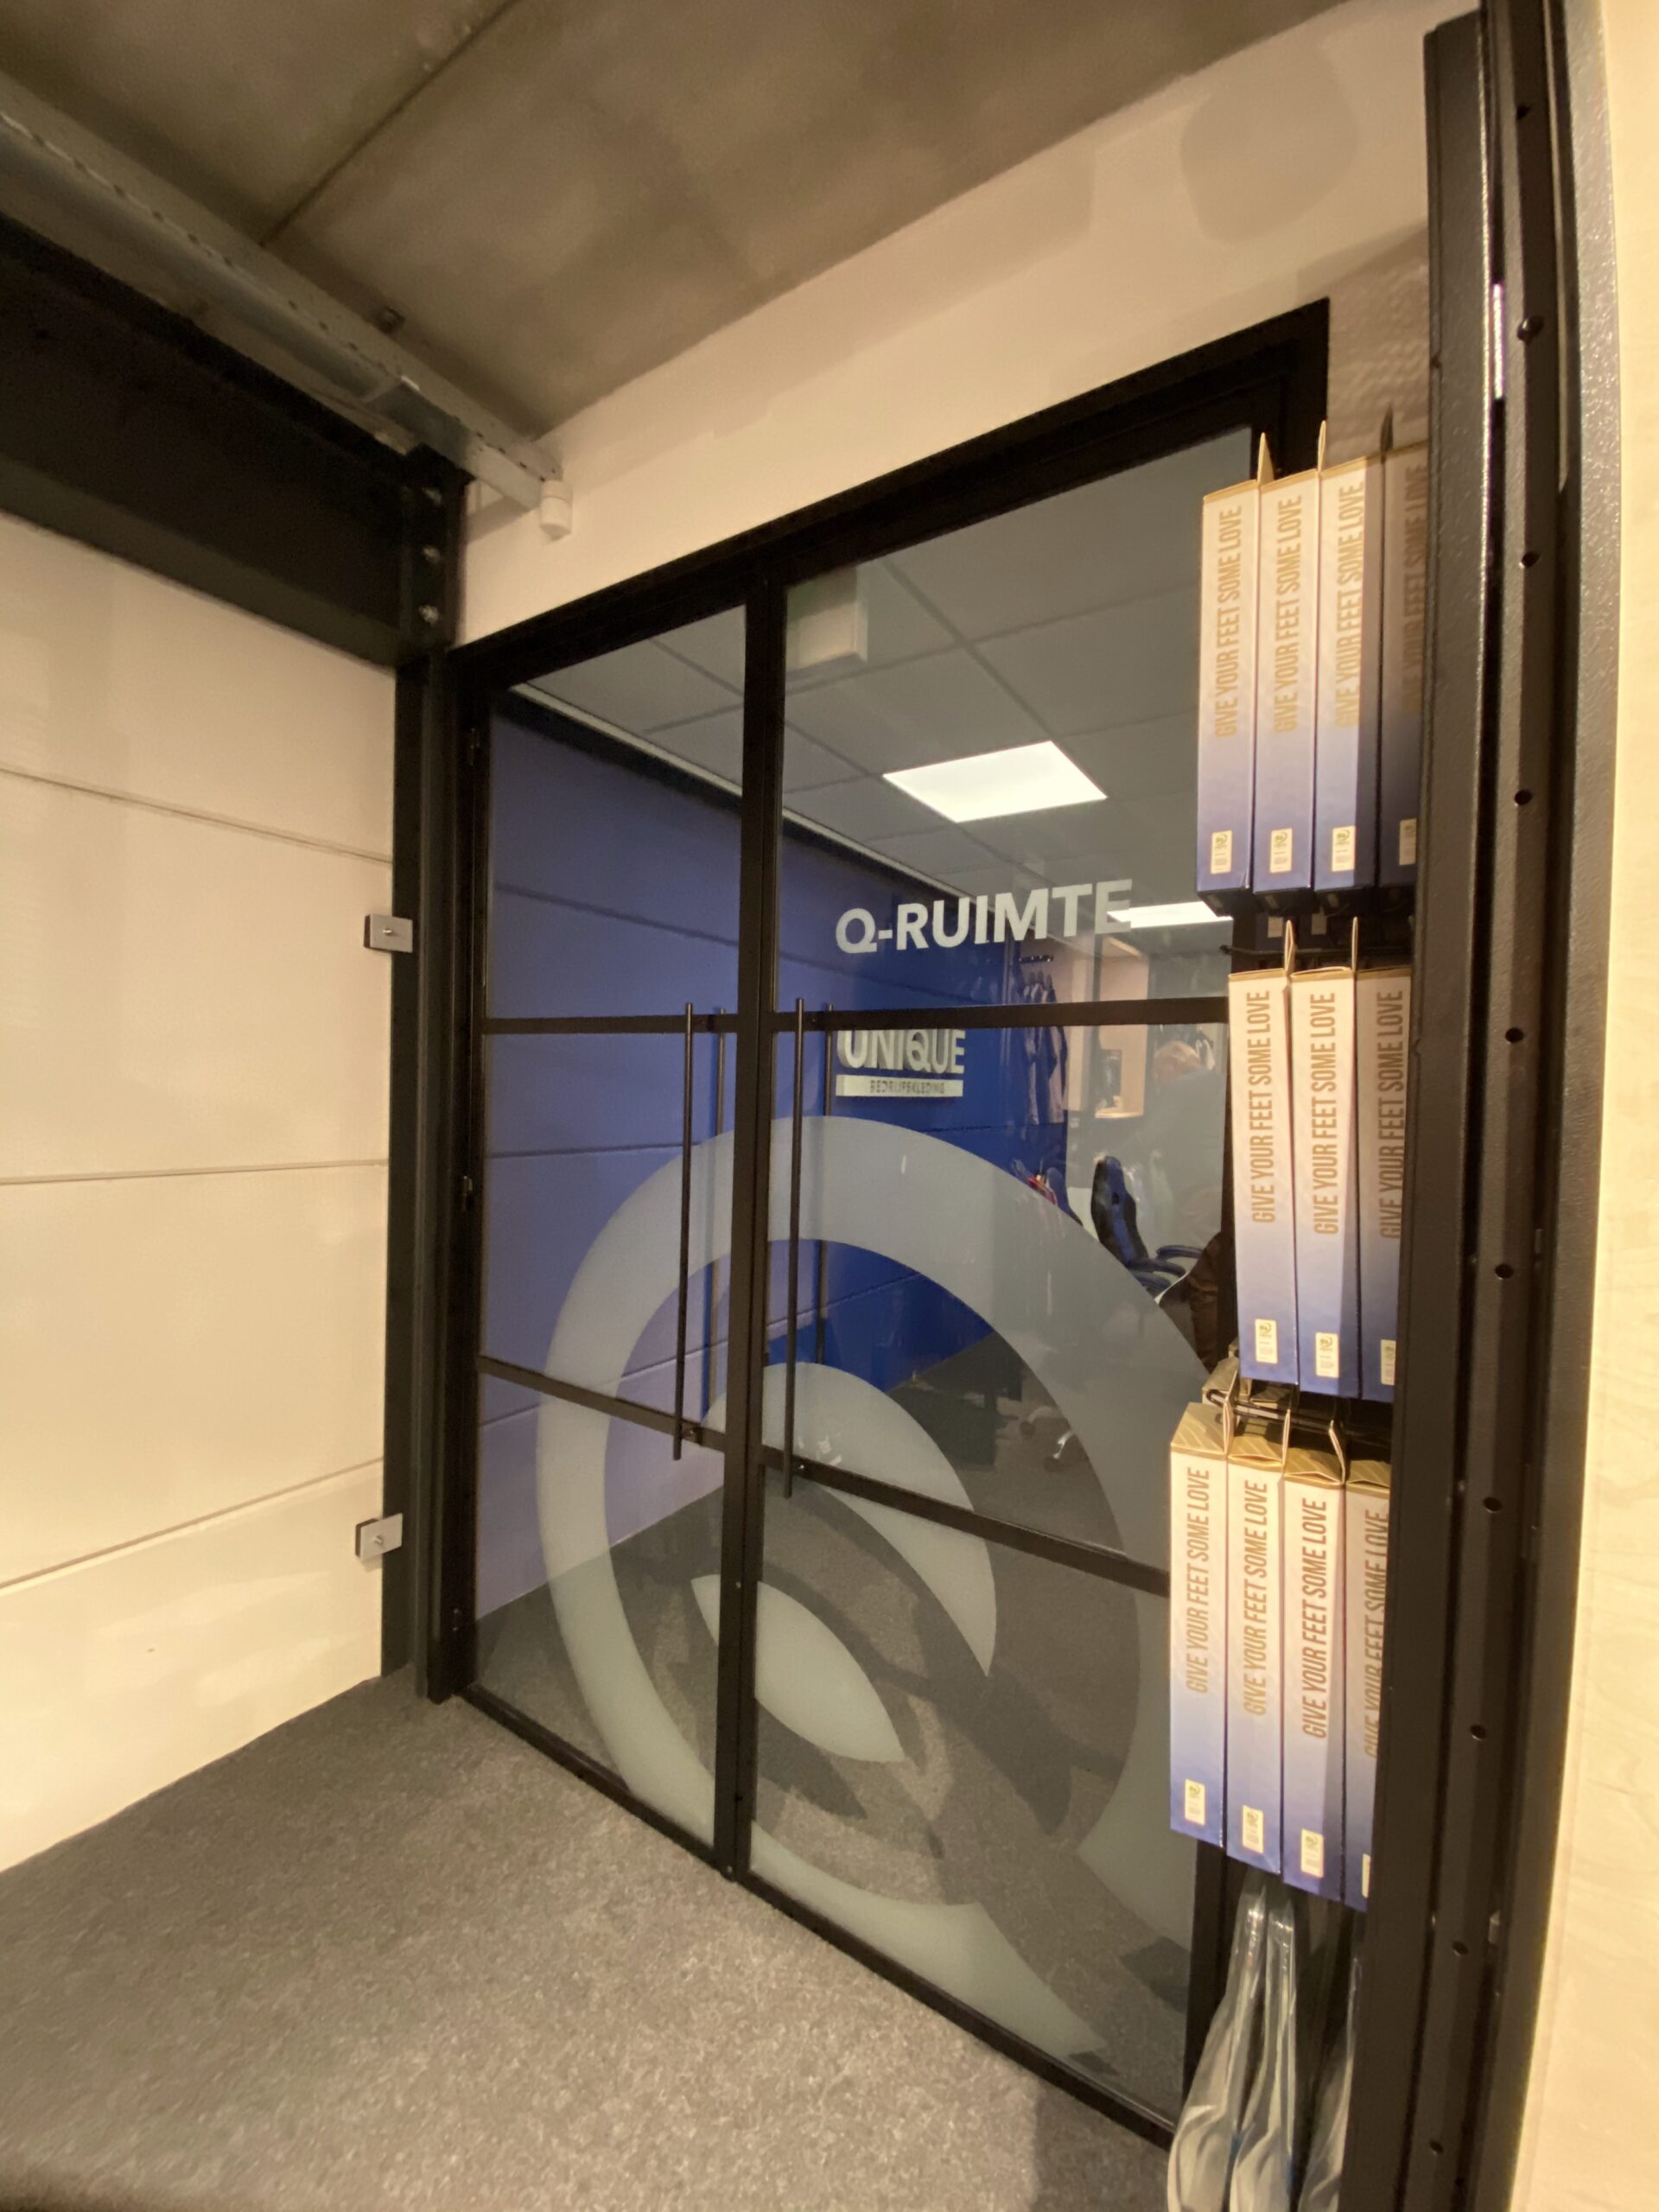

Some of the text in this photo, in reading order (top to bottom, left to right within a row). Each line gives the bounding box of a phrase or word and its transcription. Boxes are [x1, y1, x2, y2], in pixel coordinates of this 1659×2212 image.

[1215, 505, 1242, 738] GIVE YOUR FEET SOME LOVE
[1274, 495, 1301, 733] GIVE YOUR FEET SOME LOVE
[1336, 481, 1363, 727] GIVE YOUR FEET SOME LOVE
[836, 879, 1132, 954] Q-RUIMTE
[836, 1028, 966, 1074] UNIQUE
[1246, 989, 1276, 1224] GIVE YOUR FEET SOME LOVE
[1310, 992, 1339, 1236] GIVE YOUR FEET SOME LOVE
[1376, 990, 1404, 1239] GIVE YOUR FEET SOME LOVE
[1185, 1467, 1210, 1694] GIVE YOUR FEET SOME LOVE
[1243, 1480, 1268, 1716] GIVE YOUR FEET SOME LOVE
[1302, 1497, 1327, 1738] GIVE YOUR FEET SOME LOVE
[1365, 1510, 1389, 1556] LOVE
